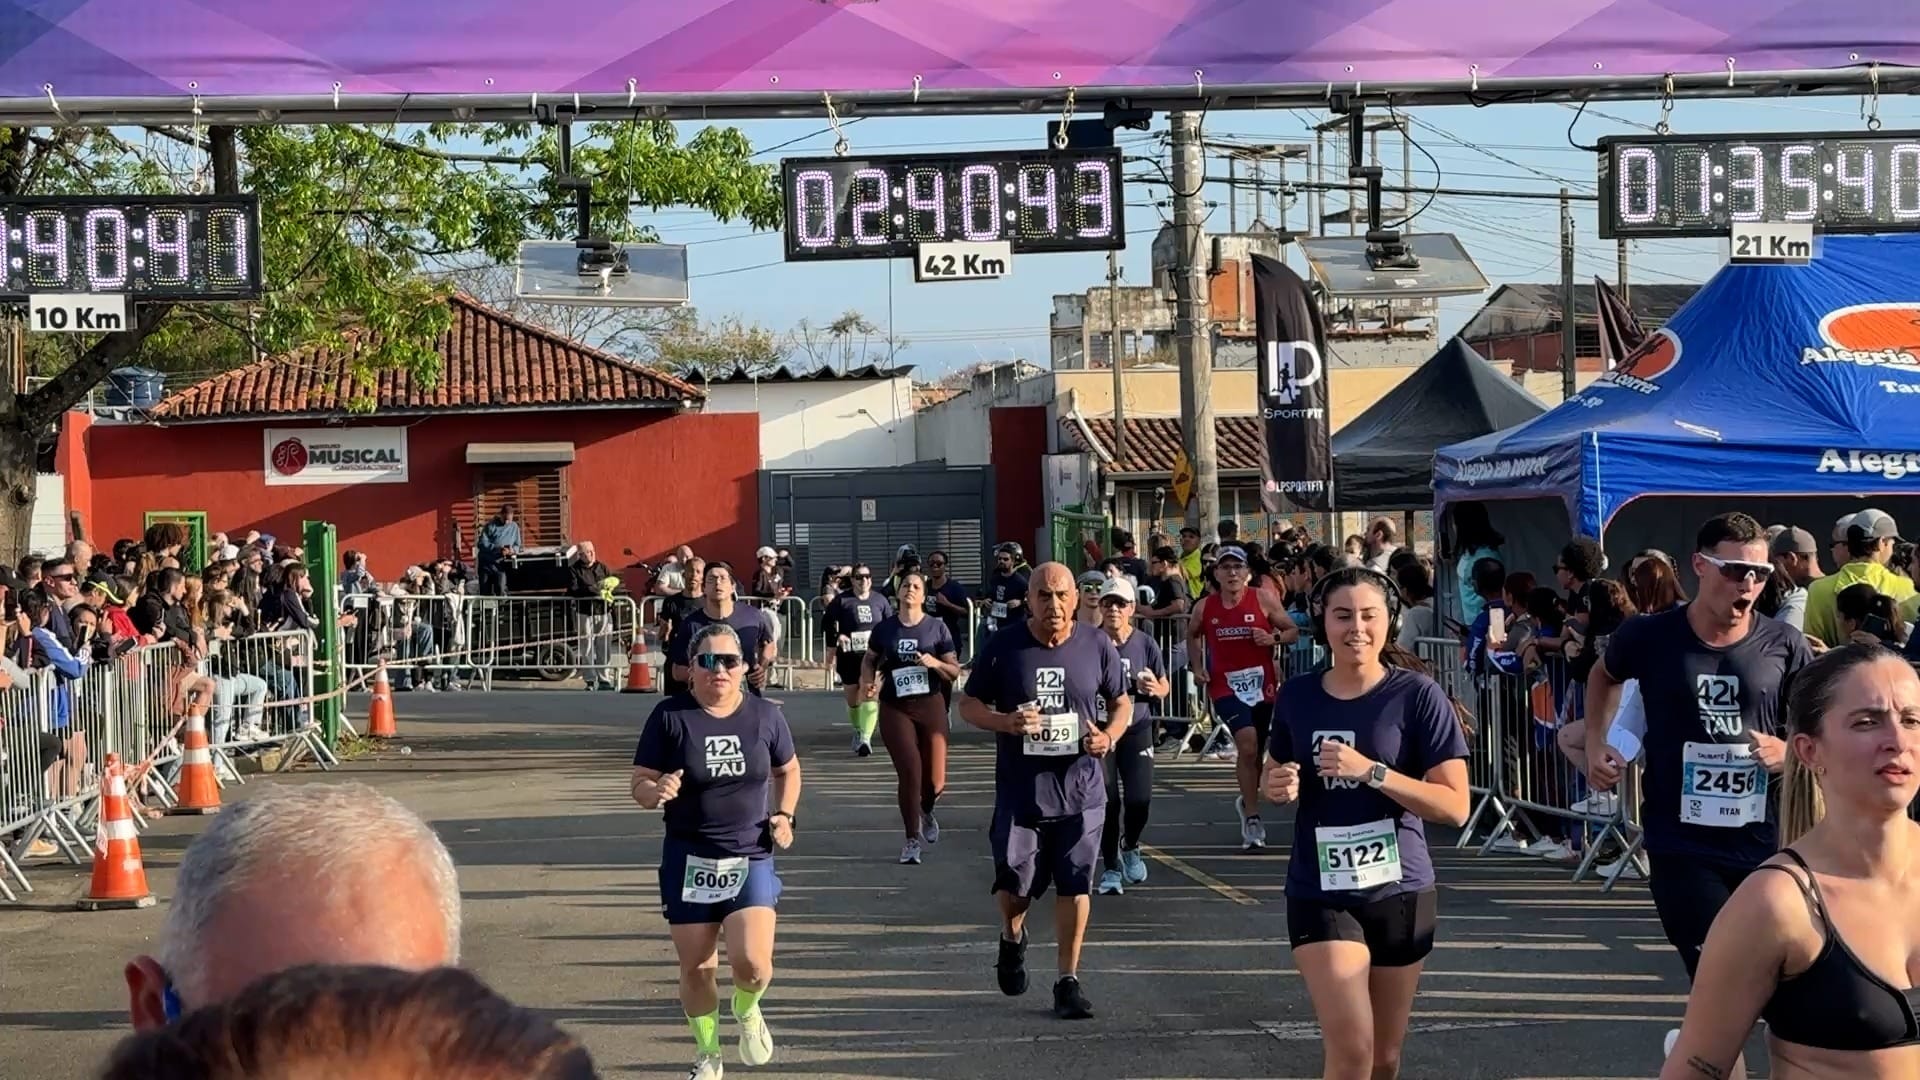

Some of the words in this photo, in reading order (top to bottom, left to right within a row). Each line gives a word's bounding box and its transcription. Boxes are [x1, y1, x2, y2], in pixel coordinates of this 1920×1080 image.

[796, 161, 1113, 247] 02:40:43
[0, 208, 247, 288] :40:41
[1736, 235, 1763, 256] 21
[1770, 235, 1810, 257] Km
[925, 255, 957, 276] 42
[963, 253, 1005, 275] Km
[35, 307, 68, 329] 10
[76, 307, 121, 329] Km
[1800, 347, 1919, 366] Alegria
[308, 449, 401, 464] MUSICAL
[1038, 695, 1064, 708] TAU
[1700, 716, 1743, 736] TAU
[706, 762, 746, 777] TAU
[1695, 769, 1756, 795] 2456
[1719, 807, 1741, 816] RYAN
[1328, 841, 1386, 869] 5122
[694, 871, 740, 889] 6003
